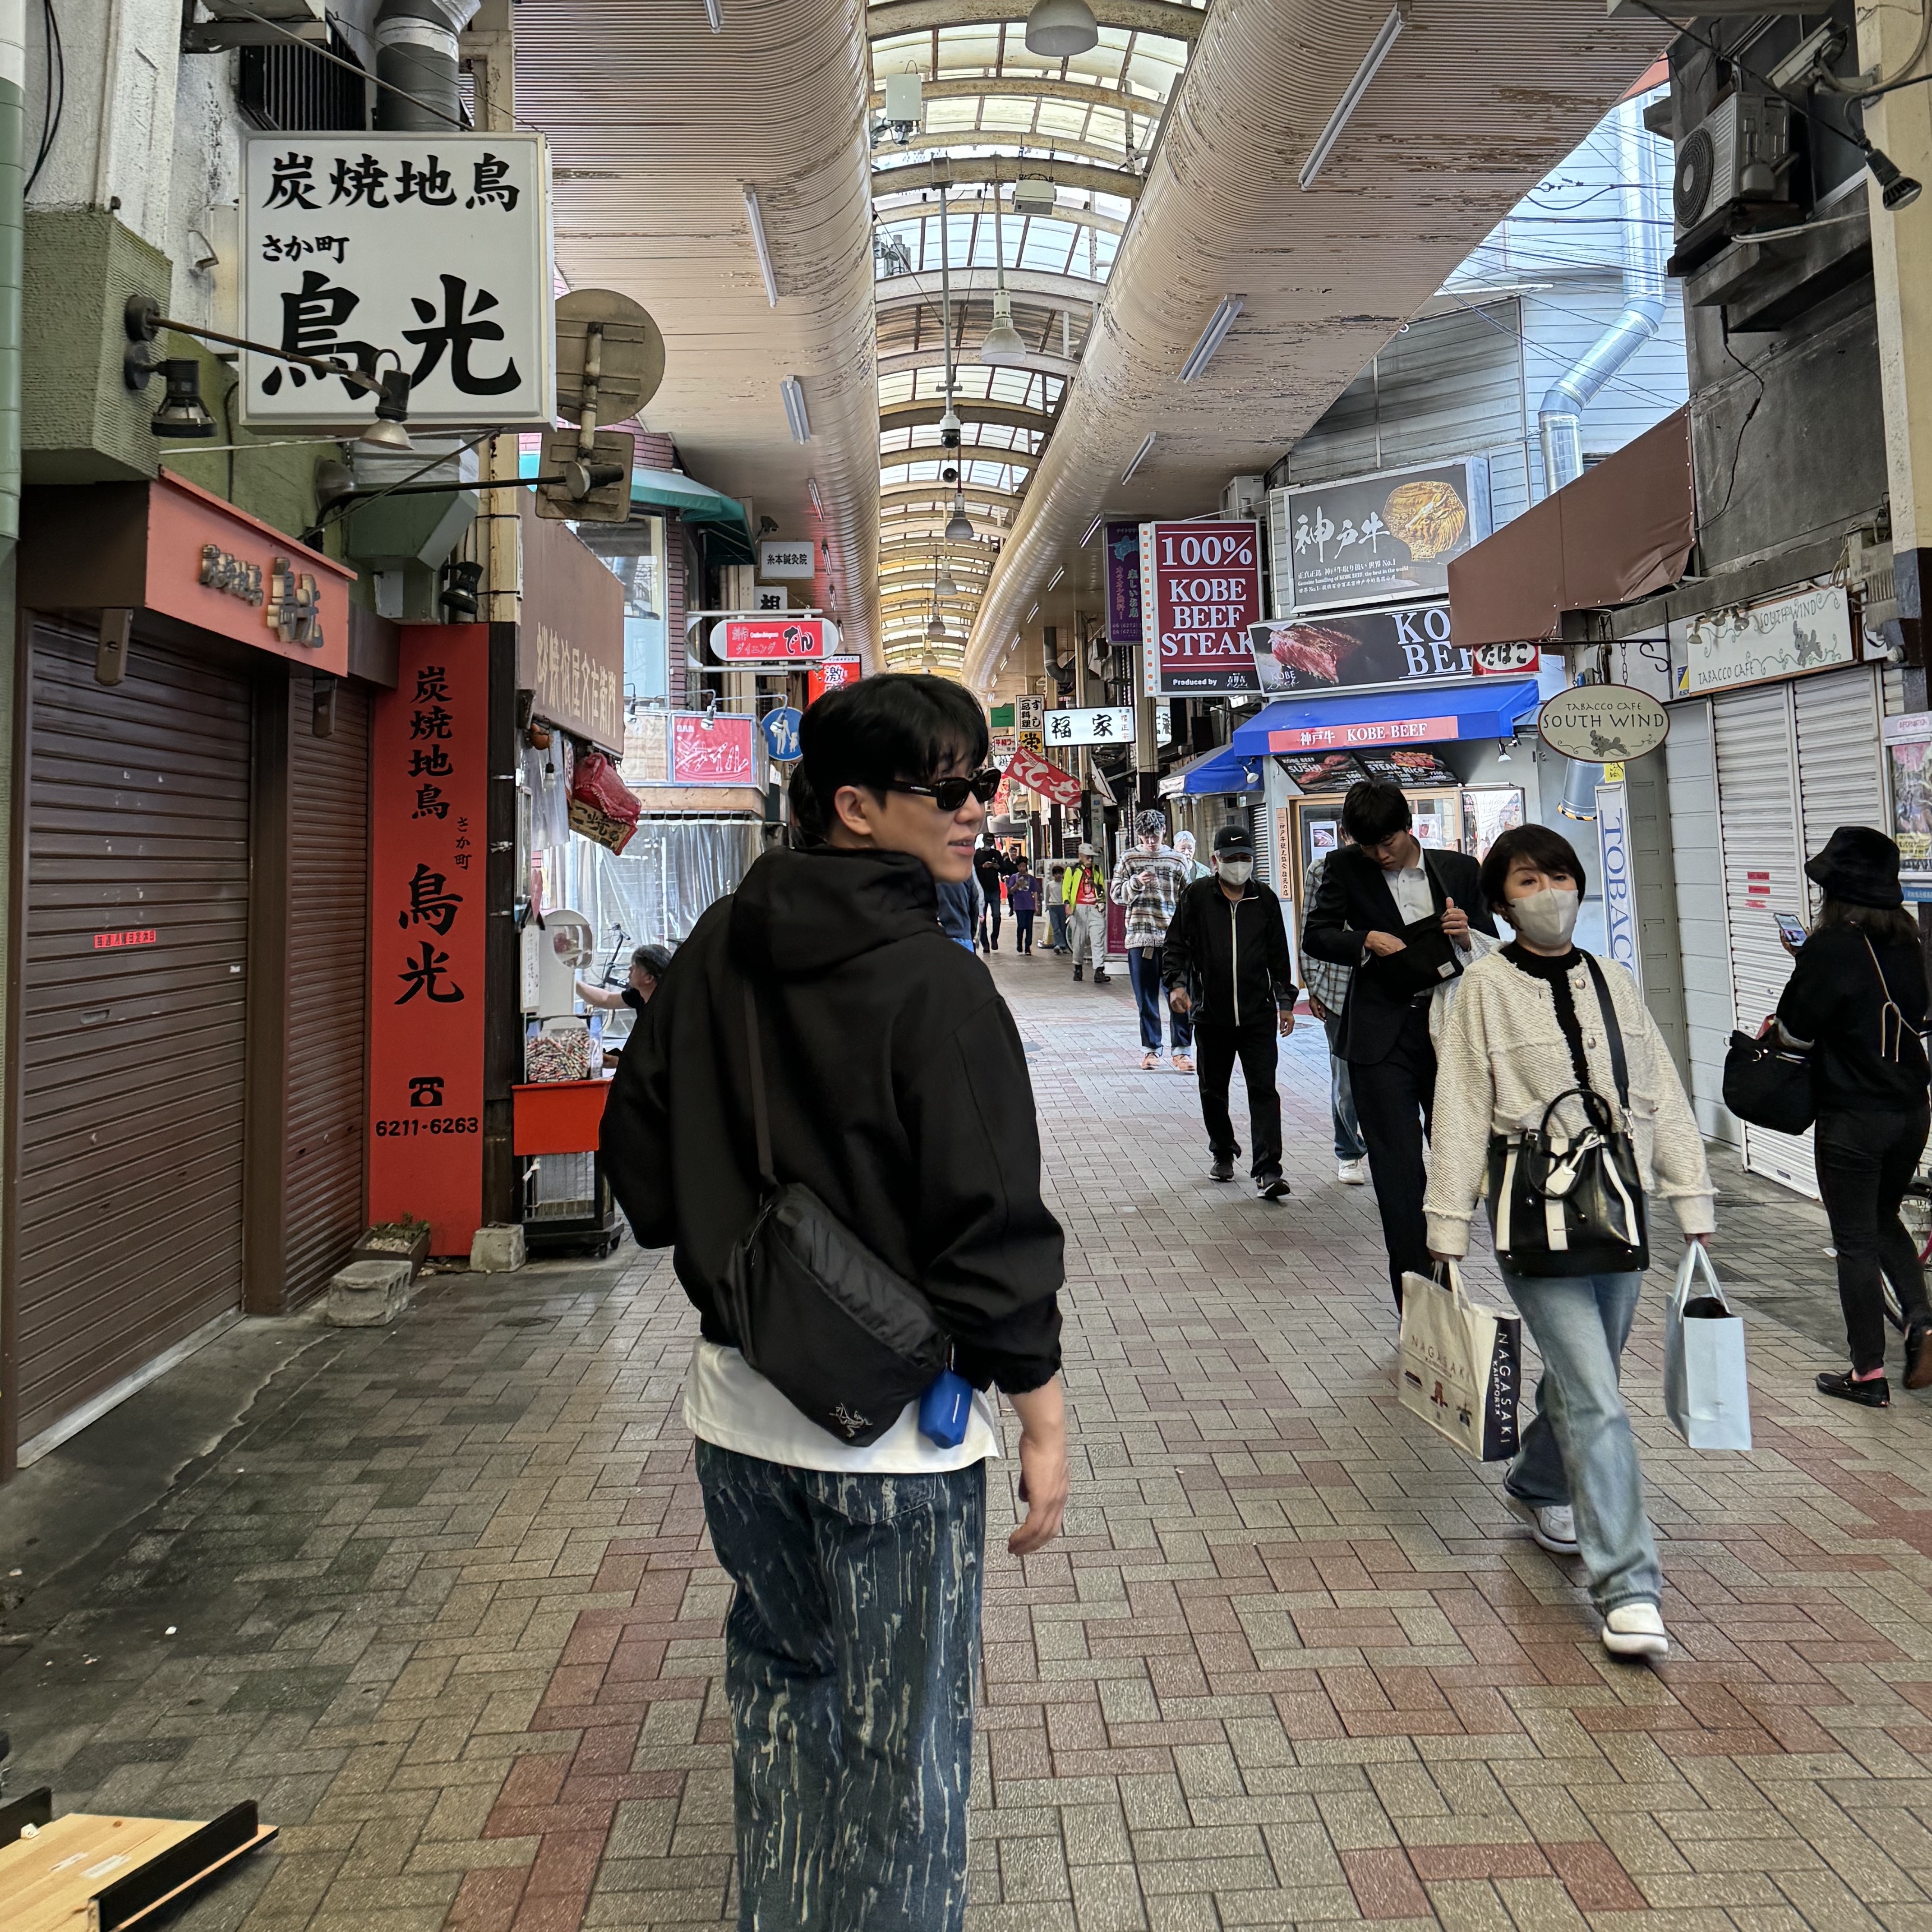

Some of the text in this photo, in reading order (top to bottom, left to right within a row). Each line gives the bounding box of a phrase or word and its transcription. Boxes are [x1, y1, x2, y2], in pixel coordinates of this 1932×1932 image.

[262, 152, 520, 212] 炭焼地鳥
[262, 235, 350, 263] さか町
[262, 270, 521, 400] 鳥光
[1295, 506, 1390, 563] 神戸牛
[1162, 536, 1252, 566] 100%
[1169, 578, 1246, 602] KOBE
[1173, 605, 1244, 629] BEEF
[736, 642, 776, 654] ダイニング
[1161, 632, 1253, 656] STEAK
[1482, 642, 1528, 666] たばこ
[1271, 671, 1296, 680] KOBE
[1735, 661, 1754, 677] CAFE
[1021, 699, 1031, 727] 一品料理
[1032, 699, 1040, 727] すし
[1617, 702, 1642, 710] CAFE
[1543, 713, 1664, 728] SOUTH WIND
[409, 666, 453, 819] 炭焼地鳥
[1300, 723, 1427, 746] 神戸牛 KOBE BEEF
[1287, 764, 1322, 773] SUSHI
[1367, 763, 1400, 771] STEAK
[454, 817, 472, 870] さか町
[394, 864, 464, 1005] 鳥光
[1496, 1332, 1512, 1443] NAGASAKI
